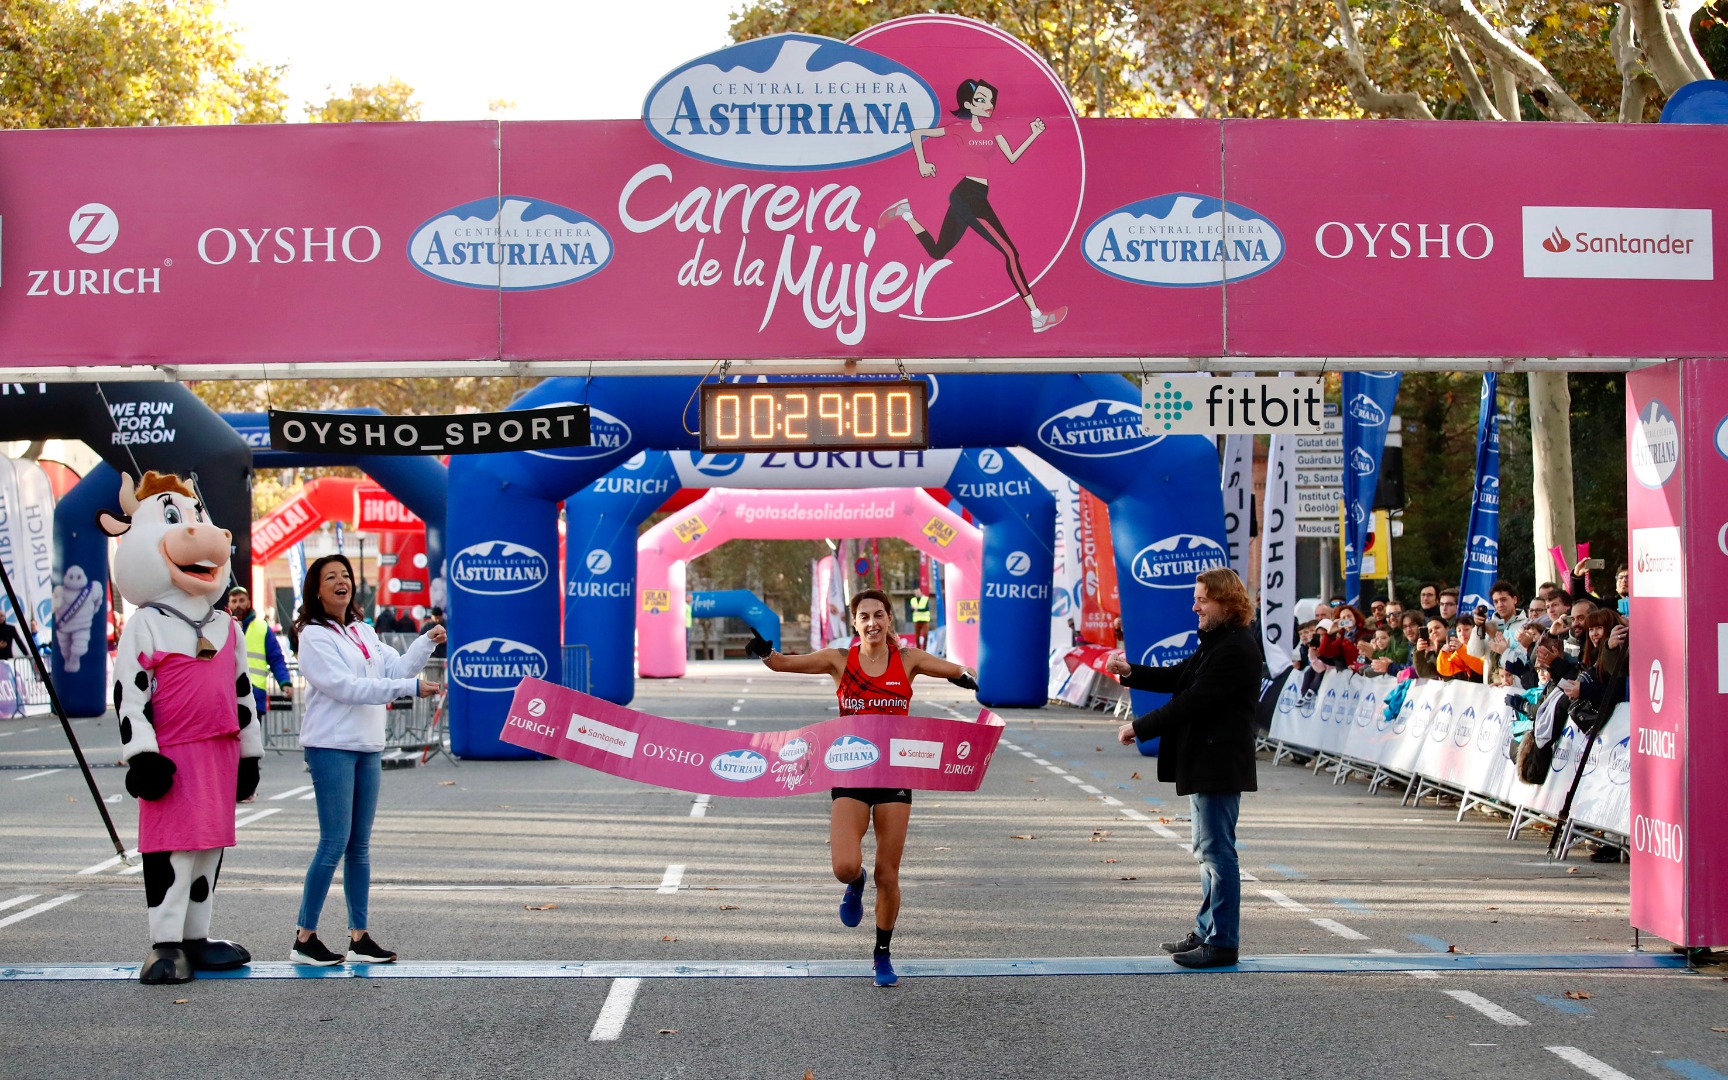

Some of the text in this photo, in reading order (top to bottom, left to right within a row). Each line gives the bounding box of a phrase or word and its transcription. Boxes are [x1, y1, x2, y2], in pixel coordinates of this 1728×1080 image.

[712, 83, 908, 95] CENTRAL LECHERA
[666, 86, 915, 135] ASTURIANA
[968, 139, 994, 147] OYSHO
[619, 164, 862, 235] Carrera
[454, 228, 591, 238] CENTRAL LECHERA
[1128, 226, 1263, 234] CENTRAL LECHERA
[198, 226, 381, 265] OYSHO
[422, 231, 598, 266] ASTURIANA
[1097, 227, 1270, 263] ASTURIANA
[1315, 222, 1494, 260] OYSHO
[1576, 232, 1694, 255] Santander
[677, 227, 954, 346] de la Mujer
[109, 402, 174, 416] WE RUN
[1206, 384, 1321, 427] fitbit
[119, 416, 165, 430] FOR A
[716, 392, 911, 439] 00:29:00
[1066, 420, 1109, 428] CENTRAL
[111, 429, 176, 445] REASON
[282, 415, 575, 451] OYSHO_SPORT
[1297, 438, 1338, 447] Ciutat del
[1297, 455, 1331, 465] Guàrdia
[593, 477, 669, 495] ZURICH
[1297, 474, 1338, 485] Pg. Santa
[958, 481, 1031, 498] ZURICH
[1299, 492, 1330, 501] Institut
[735, 501, 895, 523] #gotasdesolidaridad
[1298, 524, 1332, 533] Museus
[1153, 552, 1189, 561] CENTRAL
[454, 560, 543, 581] ASTURIANA
[568, 581, 631, 597] ZURICH
[985, 584, 1048, 600] ZURICH
[454, 656, 541, 678] ASTURIANA
[868, 696, 907, 710] running
[508, 715, 556, 738] ZURICH
[587, 728, 627, 747] Santander
[1638, 727, 1676, 760] ZURICH
[643, 743, 705, 767] OYSHO
[827, 751, 874, 765] ASTURIANA
[907, 748, 936, 759] Santander
[714, 758, 763, 774] ASTURIANA
[944, 763, 975, 775] ZURICH
[1634, 814, 1683, 863] OYSHO
